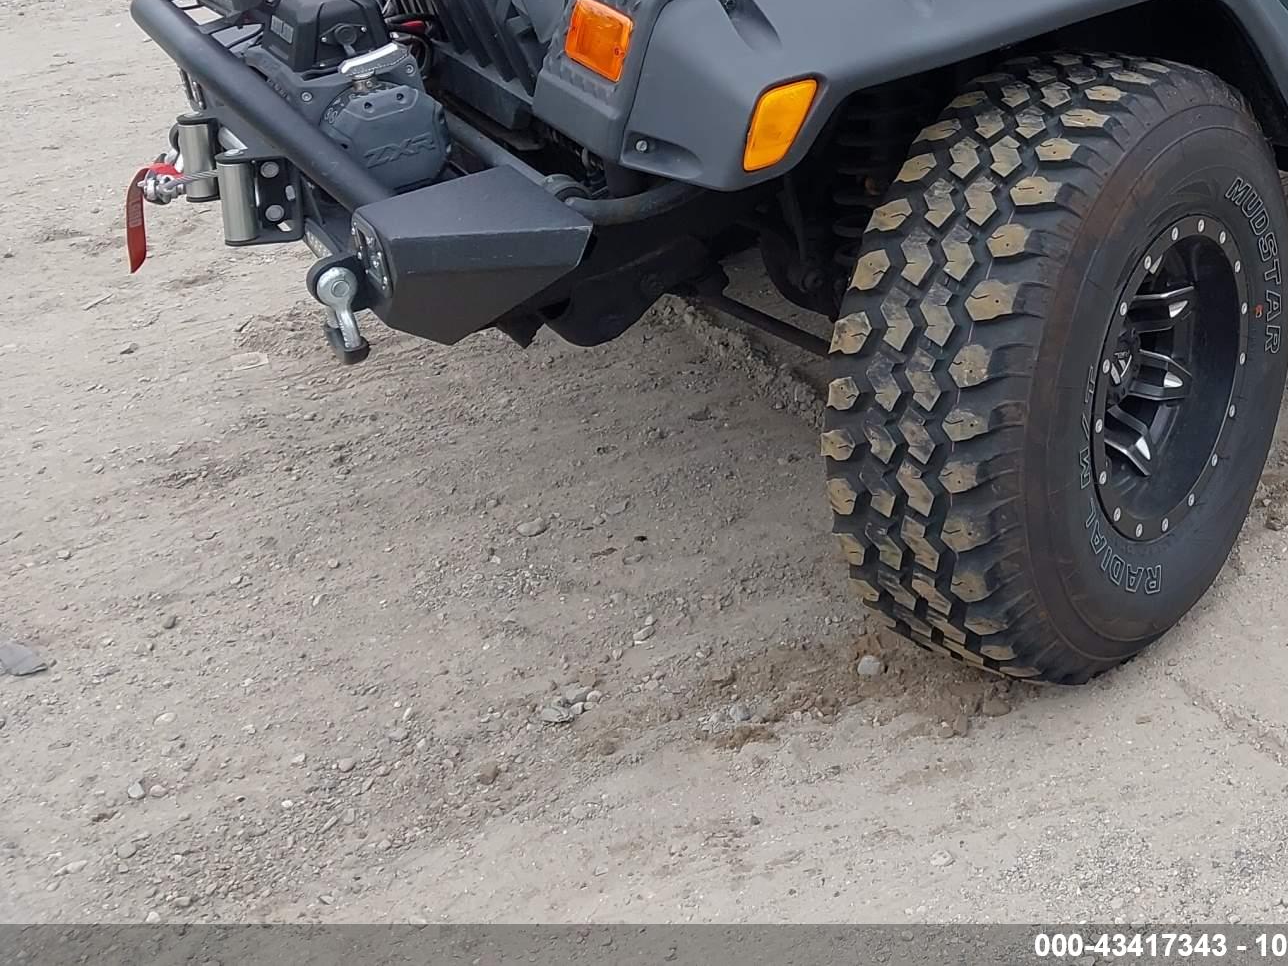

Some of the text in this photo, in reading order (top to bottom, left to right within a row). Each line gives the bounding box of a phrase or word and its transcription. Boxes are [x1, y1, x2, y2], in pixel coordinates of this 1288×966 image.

[364, 132, 437, 169] ZXR
[1224, 177, 1282, 354] MUDSTAR
[1085, 498, 1162, 595] RADIAL
